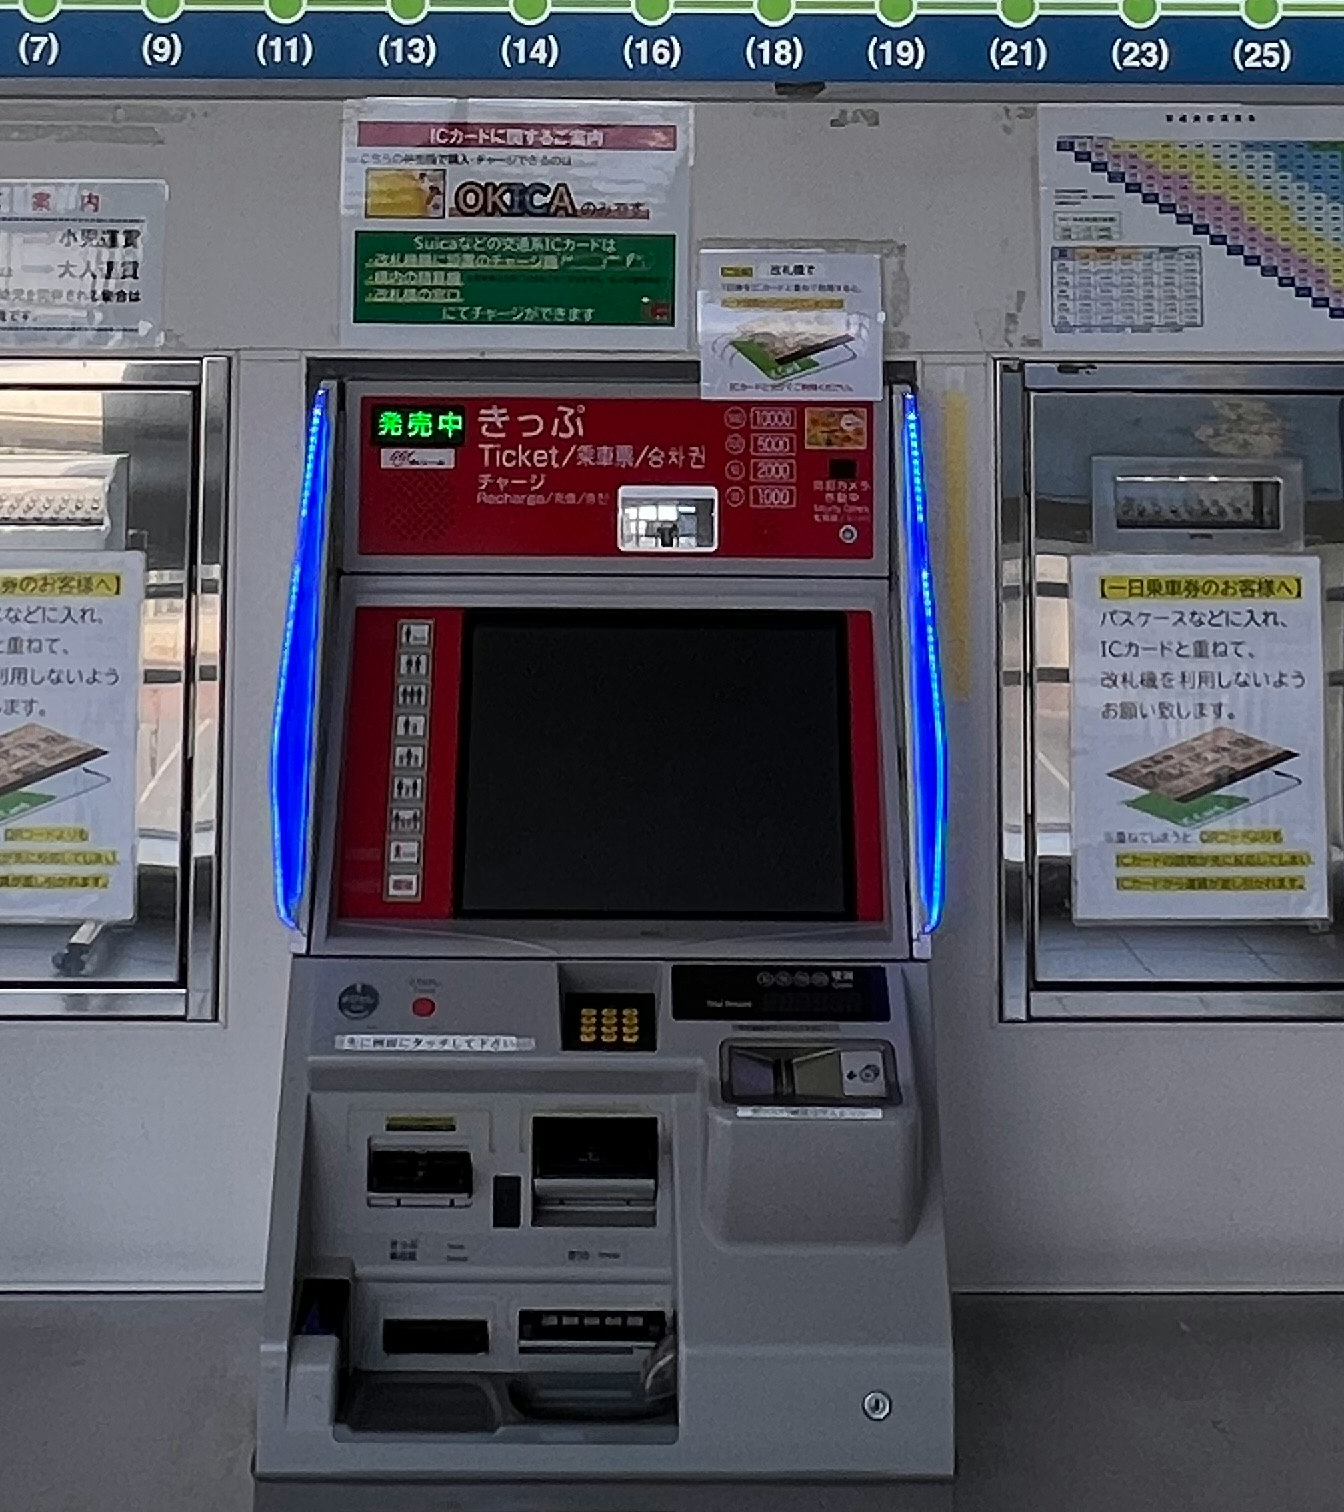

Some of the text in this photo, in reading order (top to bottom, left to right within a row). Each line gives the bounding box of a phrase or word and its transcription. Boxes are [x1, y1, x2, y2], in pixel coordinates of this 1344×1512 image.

[18, 35, 60, 66] (7)
[141, 36, 183, 67] (9)
[256, 36, 314, 66] (11)
[377, 37, 438, 68] (13)
[500, 37, 560, 68] (14)
[622, 37, 683, 68] (16)
[744, 38, 805, 68] (18)
[866, 38, 927, 69] (19)
[988, 38, 1048, 70] (21)
[1110, 39, 1170, 71] (23)
[1232, 40, 1291, 71] (25)
[455, 182, 577, 217] OKICA
[377, 410, 463, 438] 発売中
[477, 405, 587, 439] きっぷ
[1100, 671, 1307, 690] 改札機を利用しないよう
